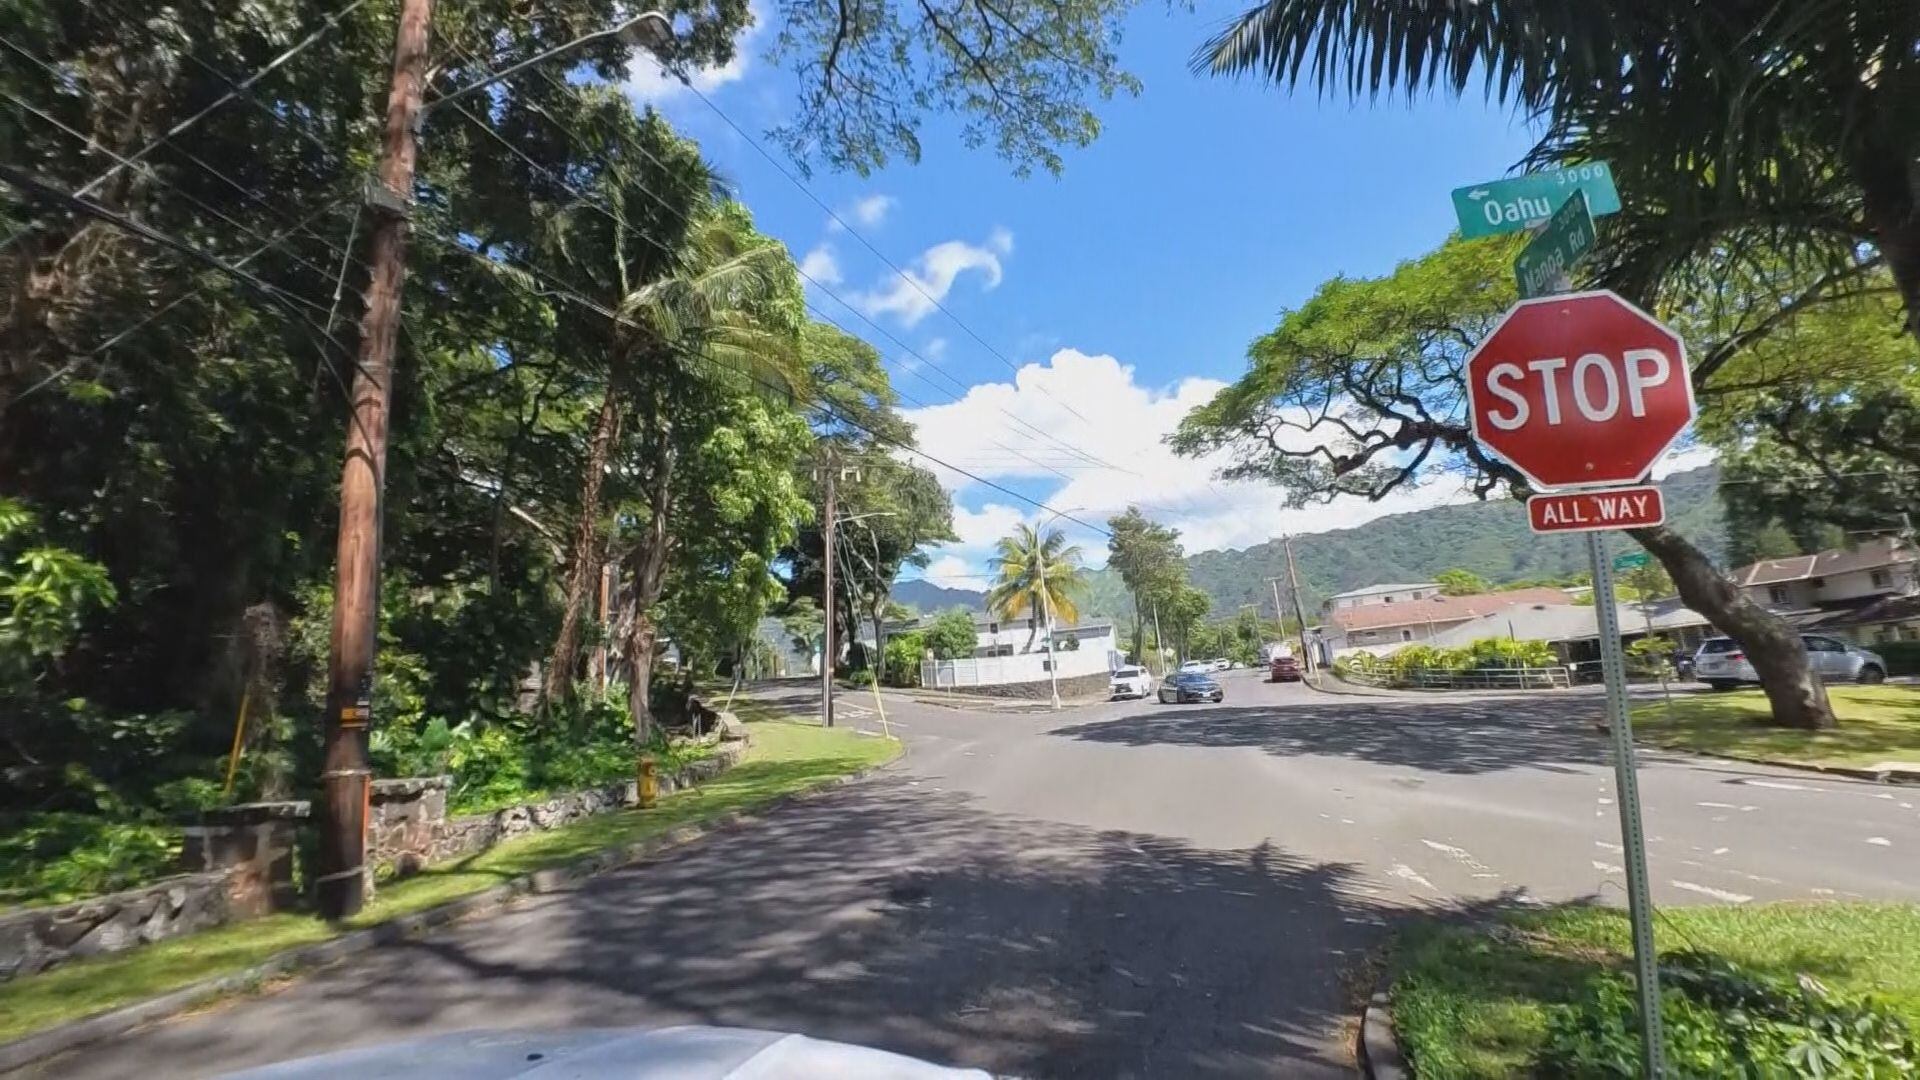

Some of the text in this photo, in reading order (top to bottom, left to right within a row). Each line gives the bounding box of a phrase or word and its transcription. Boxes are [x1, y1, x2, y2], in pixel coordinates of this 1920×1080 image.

[1555, 165, 1604, 185] 3000
[1484, 196, 1552, 226] Oahu
[1569, 225, 1586, 254] Rd
[1486, 347, 1670, 431] STOP
[1543, 495, 1648, 525] ALL WAY
